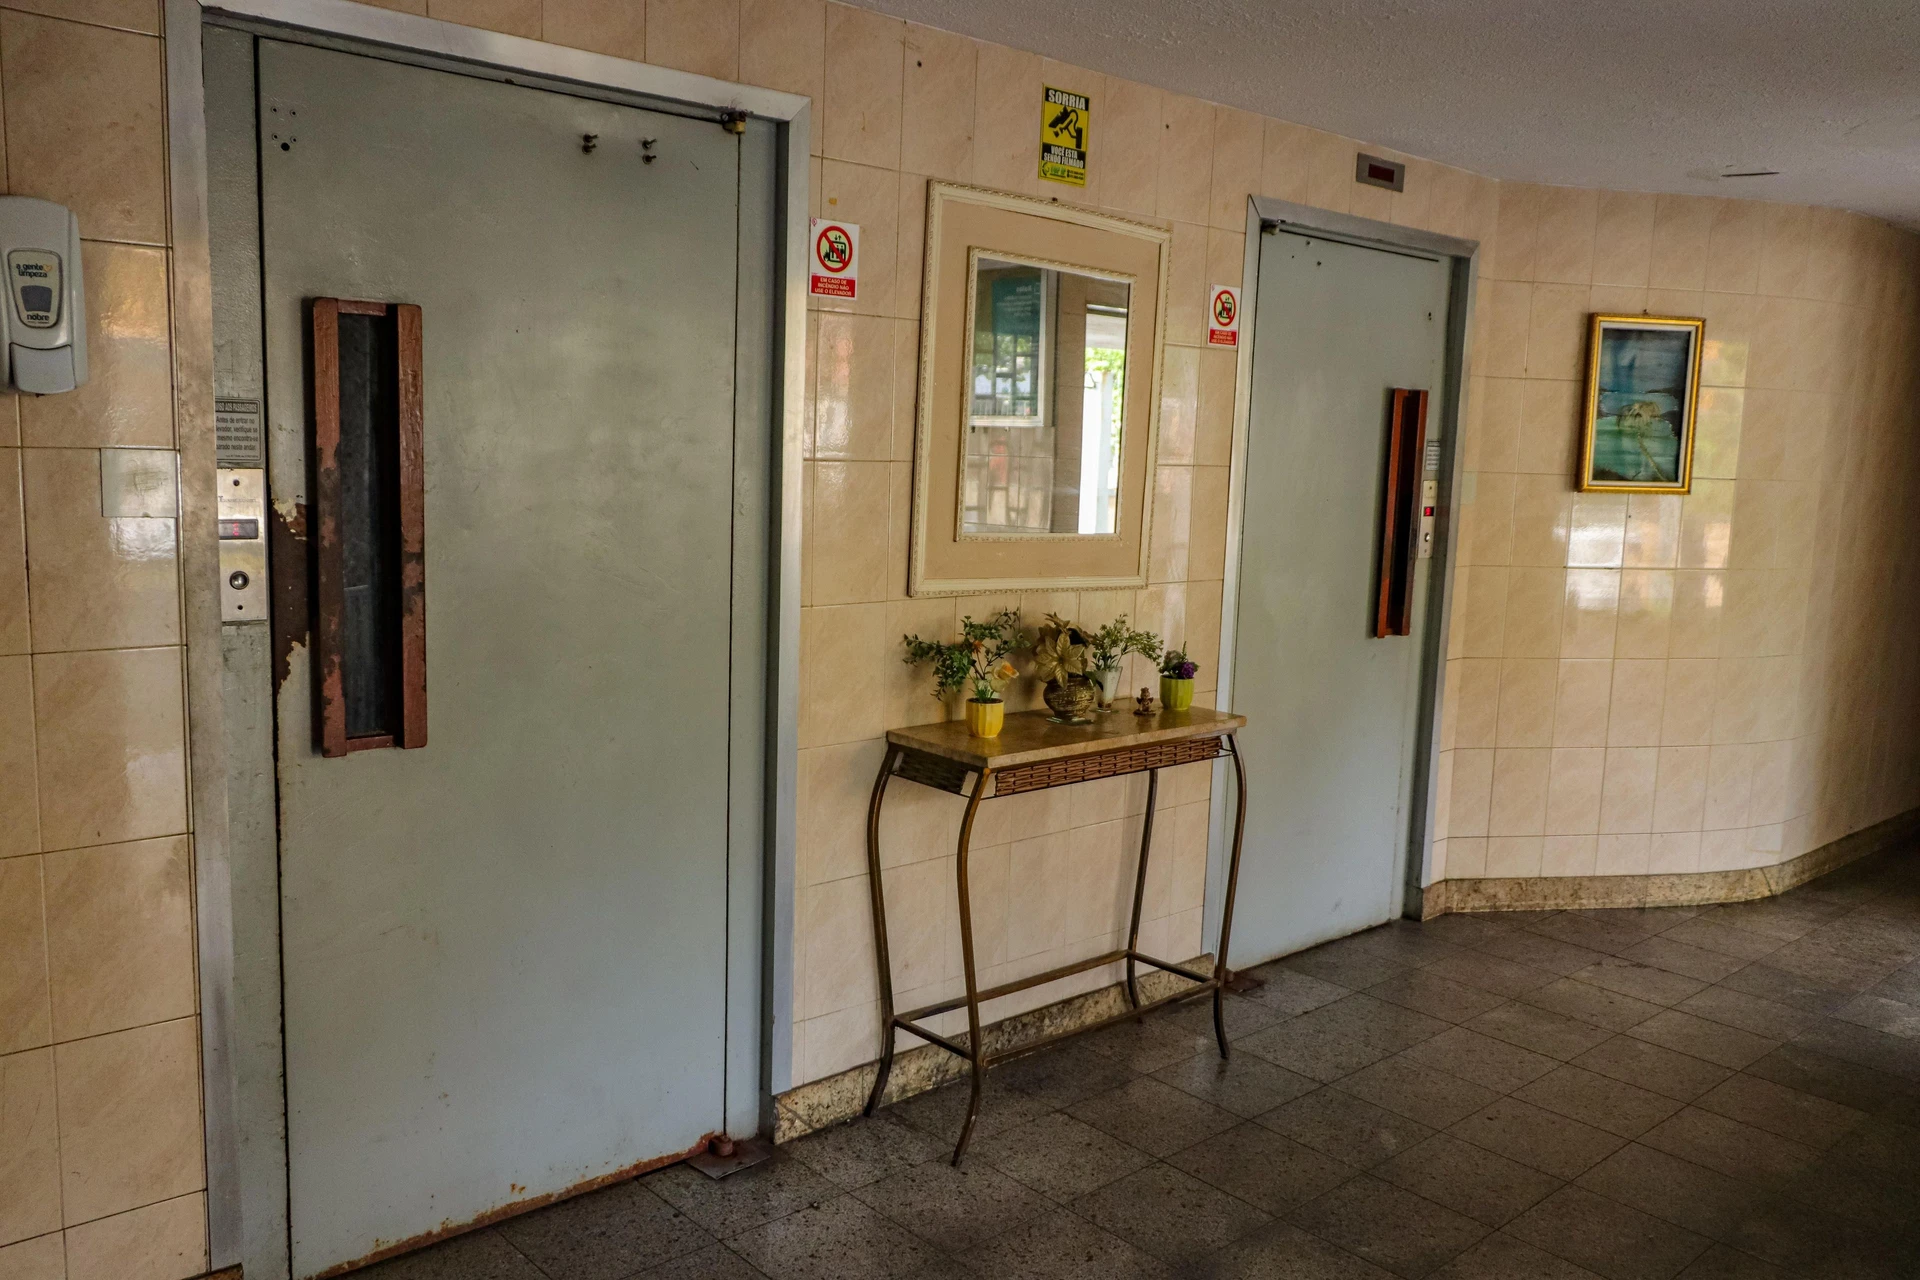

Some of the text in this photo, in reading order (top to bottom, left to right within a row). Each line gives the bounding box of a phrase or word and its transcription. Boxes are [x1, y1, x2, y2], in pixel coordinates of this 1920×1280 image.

[1048, 90, 1086, 110] SORRIA
[1044, 152, 1083, 168] SENDO FILMADO
[19, 270, 47, 278] limpeza
[233, 403, 257, 412] PASSAGEIROS
